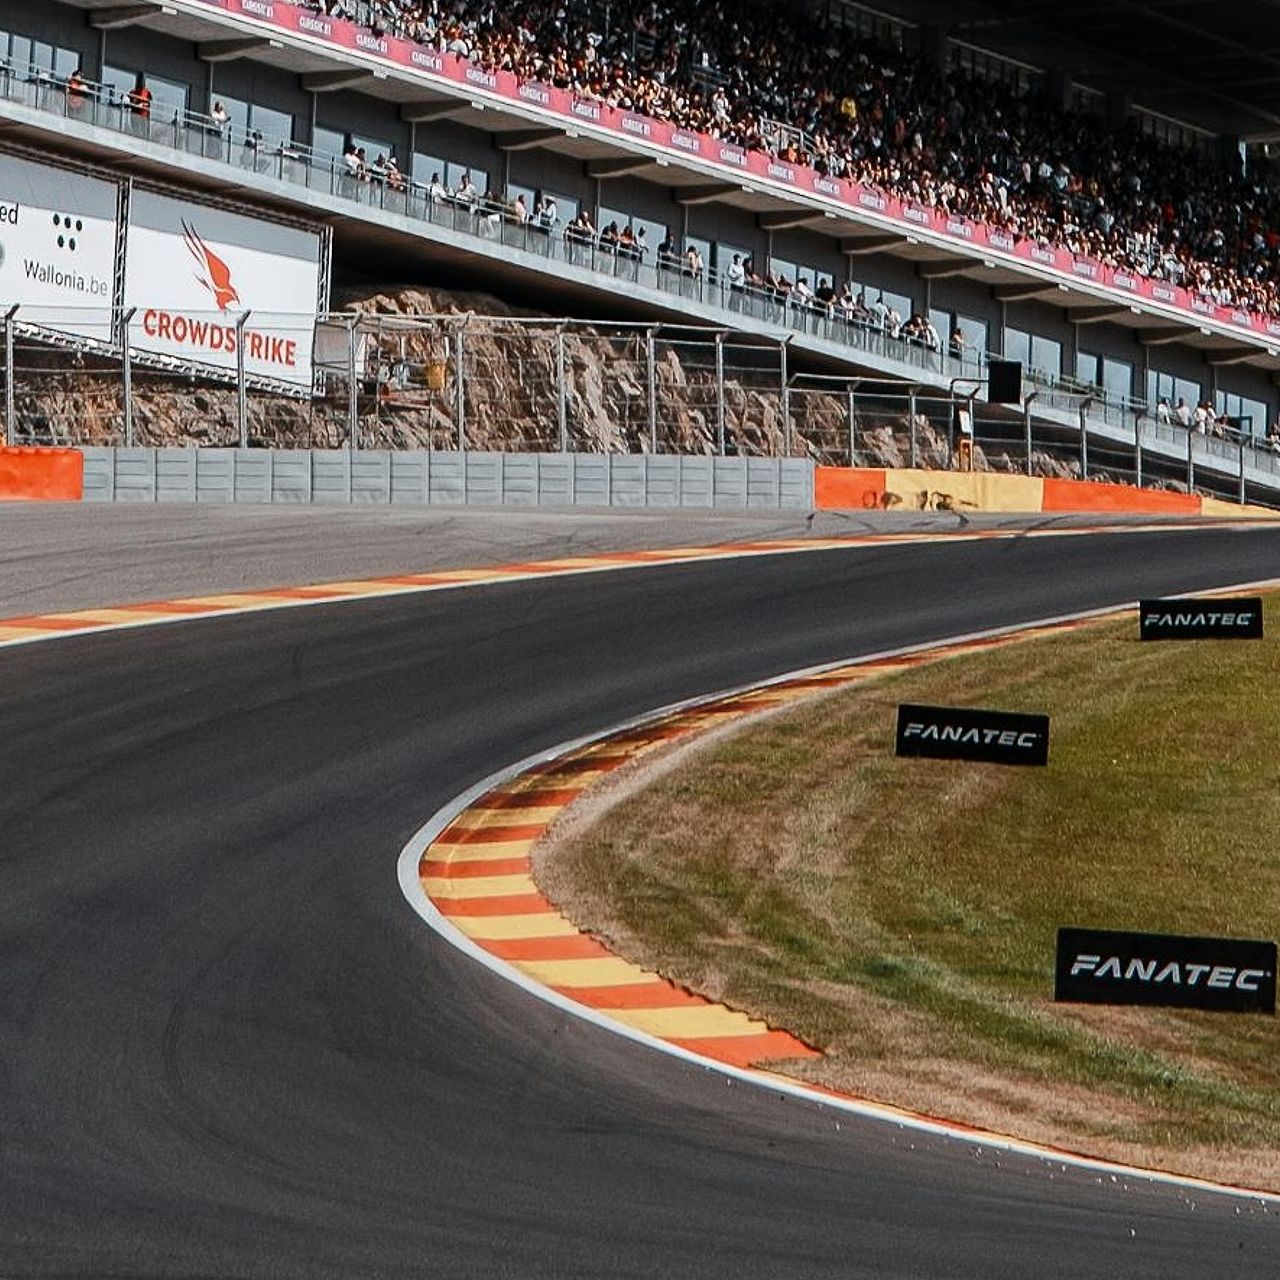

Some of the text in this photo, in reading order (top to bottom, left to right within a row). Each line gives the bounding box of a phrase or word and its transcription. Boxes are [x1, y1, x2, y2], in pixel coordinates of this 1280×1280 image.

[23, 258, 108, 297] Wallonia.be
[1144, 613, 1252, 626] FANATEC
[903, 723, 1038, 748] FANATEC
[1071, 954, 1265, 991] FANATEC
